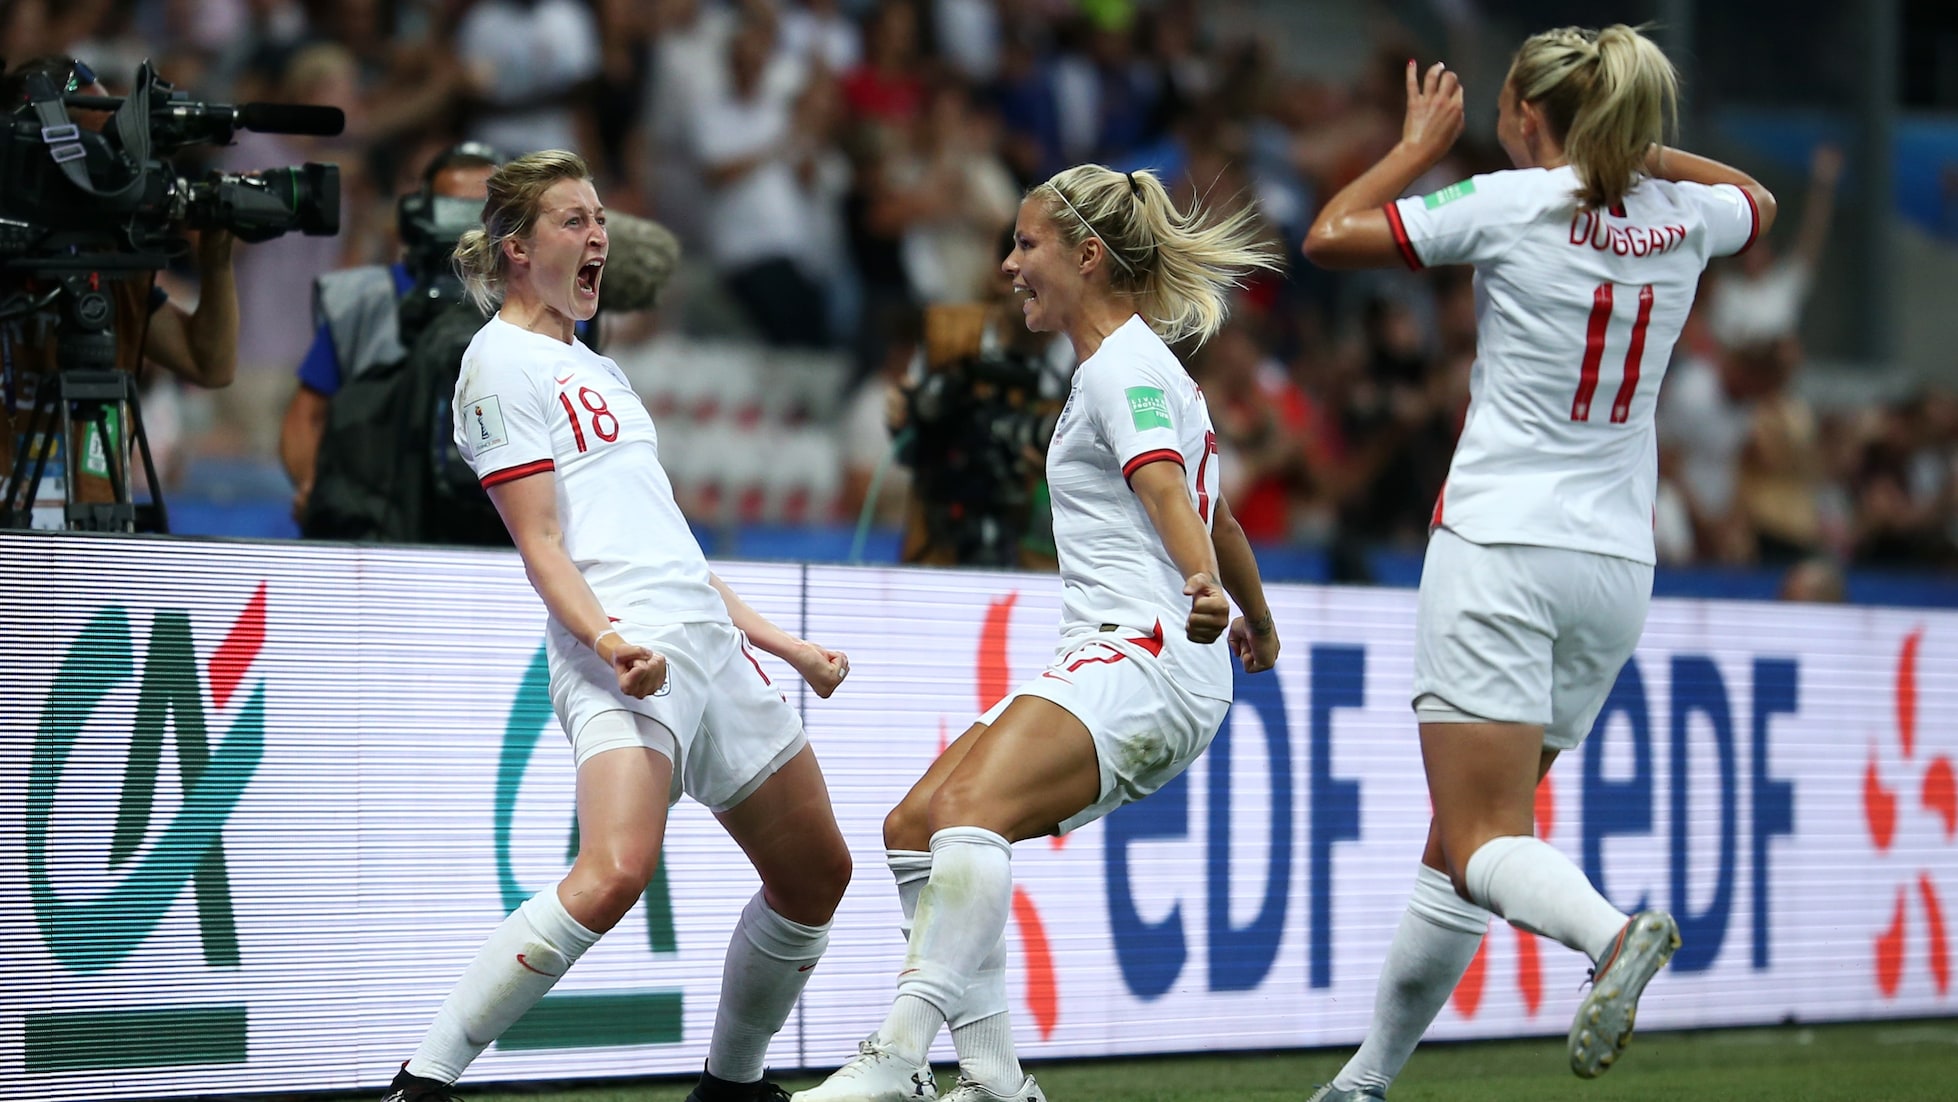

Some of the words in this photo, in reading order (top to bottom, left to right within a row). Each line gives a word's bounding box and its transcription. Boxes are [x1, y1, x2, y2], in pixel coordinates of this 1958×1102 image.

[1569, 207, 1687, 258] DUGGAN
[1570, 281, 1654, 424] 11
[558, 386, 620, 454] 18
